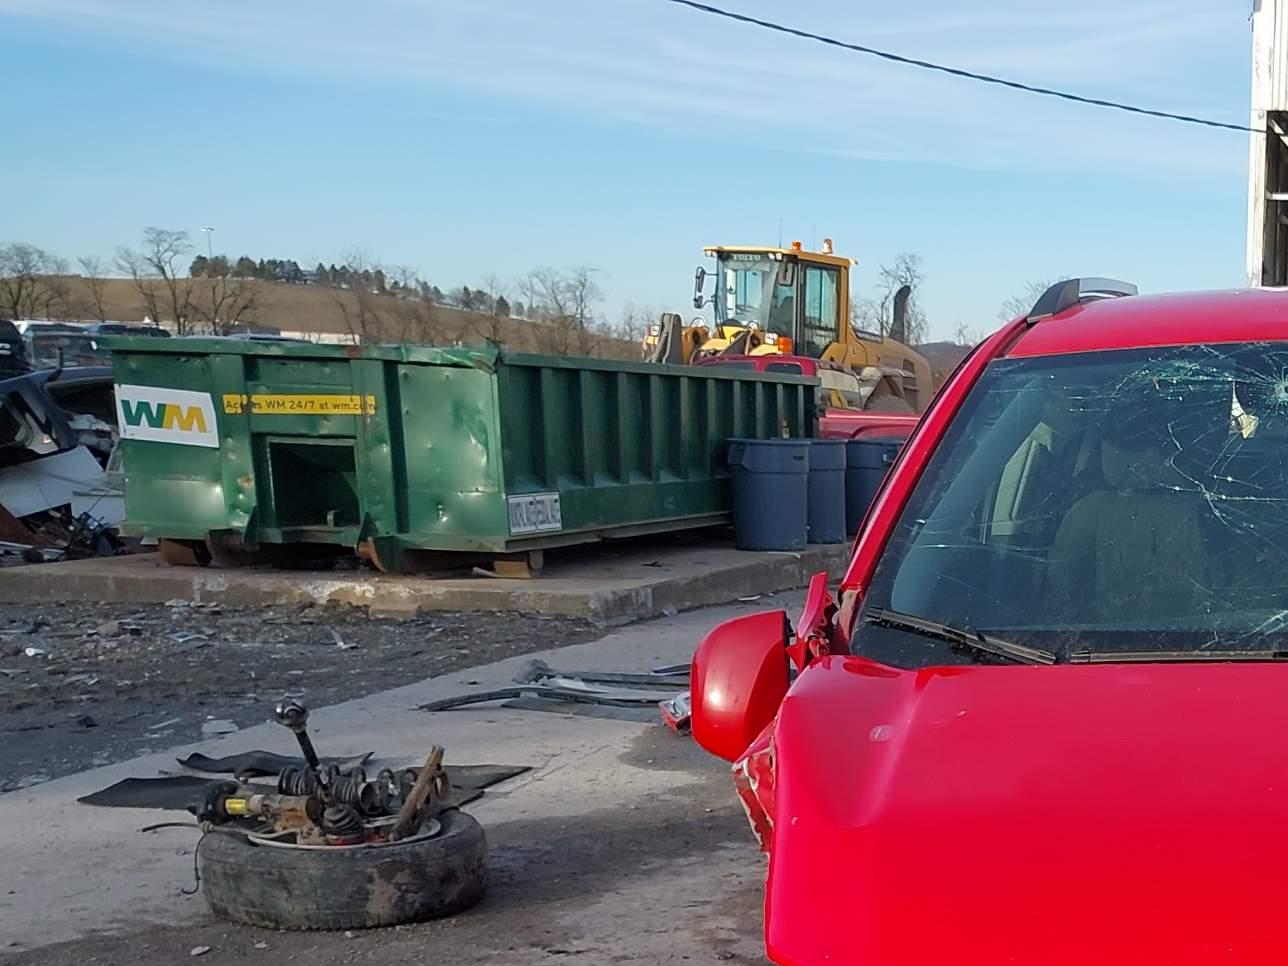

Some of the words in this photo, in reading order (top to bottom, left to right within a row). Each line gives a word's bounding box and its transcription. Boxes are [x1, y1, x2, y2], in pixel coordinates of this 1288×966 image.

[265, 400, 285, 409] WM
[289, 400, 314, 410] 24/7
[319, 402, 328, 410] at
[120, 400, 208, 433] WM
